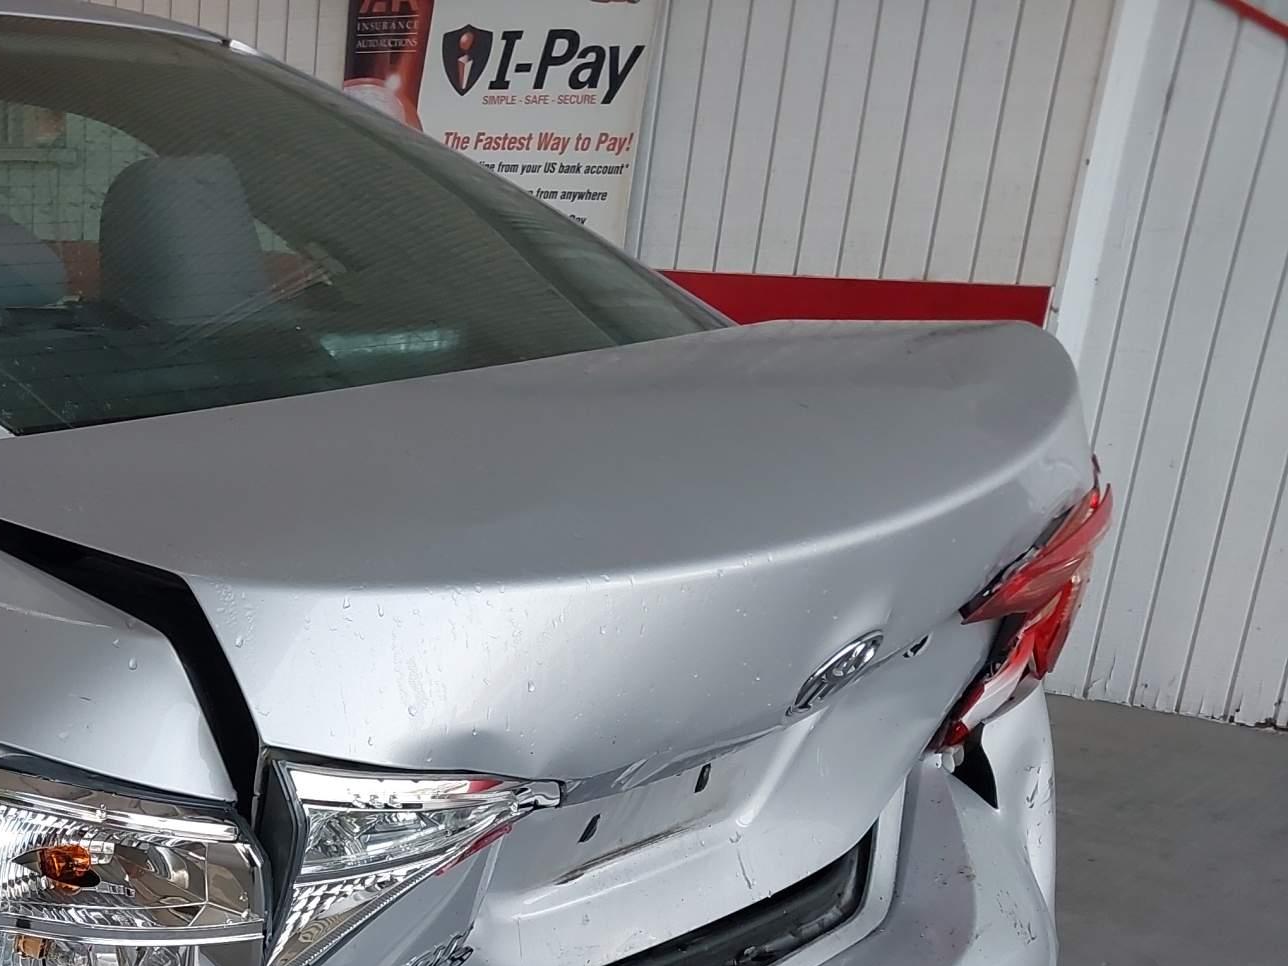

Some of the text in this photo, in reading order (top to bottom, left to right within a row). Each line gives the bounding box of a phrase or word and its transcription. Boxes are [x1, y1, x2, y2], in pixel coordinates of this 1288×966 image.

[357, 20, 418, 32] INSURANCE
[488, 29, 646, 104] I-Pay
[482, 95, 517, 105] SIMPLE
[524, 95, 550, 105] SAFE
[557, 94, 597, 105] SECURE
[444, 131, 634, 156] The Fastest Way to Pay!
[497, 161, 519, 173] from
[519, 164, 543, 175] your
[543, 162, 557, 174] US
[559, 162, 582, 174] bank
[535, 188, 558, 200] from
[560, 188, 608, 202] anywhere
